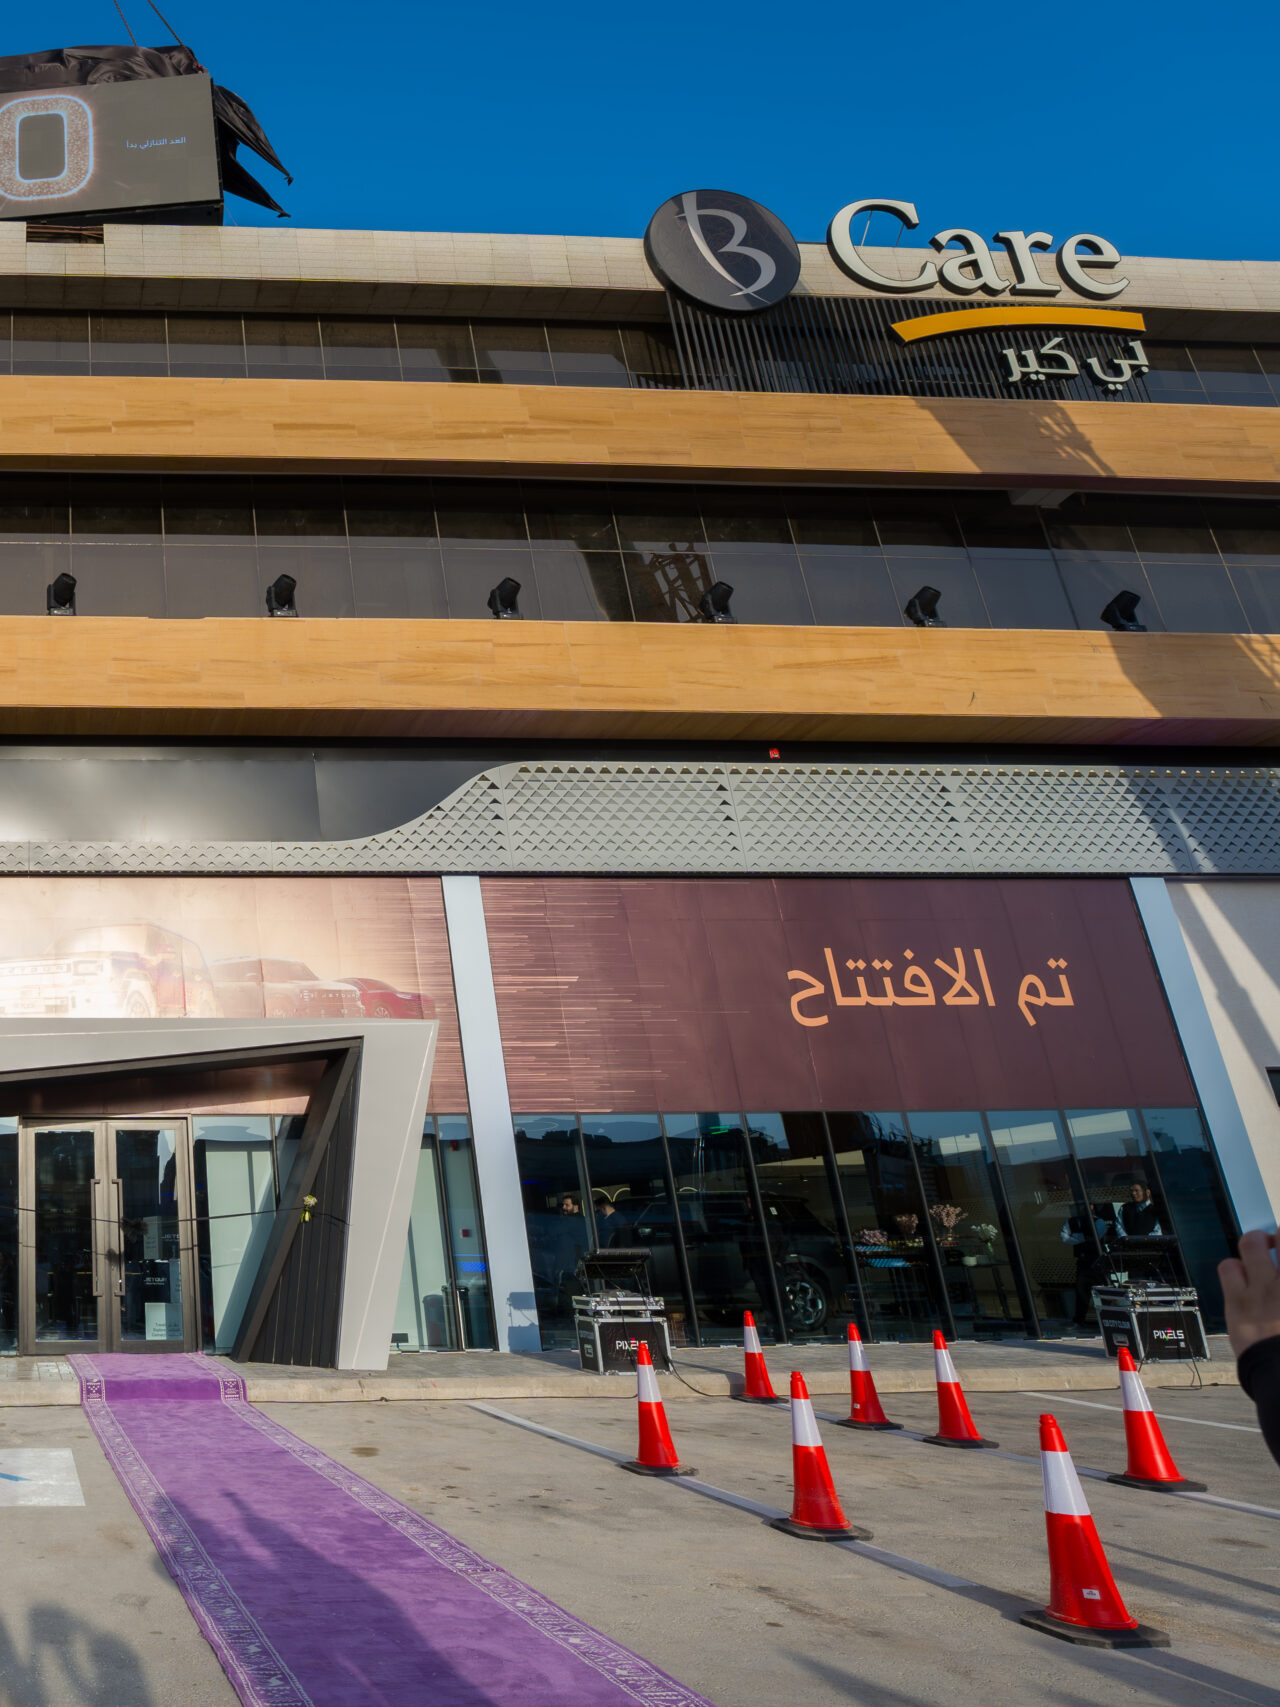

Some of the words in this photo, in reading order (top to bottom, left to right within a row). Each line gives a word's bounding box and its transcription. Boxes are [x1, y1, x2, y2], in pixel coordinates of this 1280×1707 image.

[829, 198, 1130, 300] Care
[1002, 337, 1081, 383] كير
[1087, 340, 1149, 391] بي
[787, 948, 996, 1027] الافتتاح
[1018, 957, 1074, 1027] تم
[1153, 1329, 1185, 1340] PIXELS
